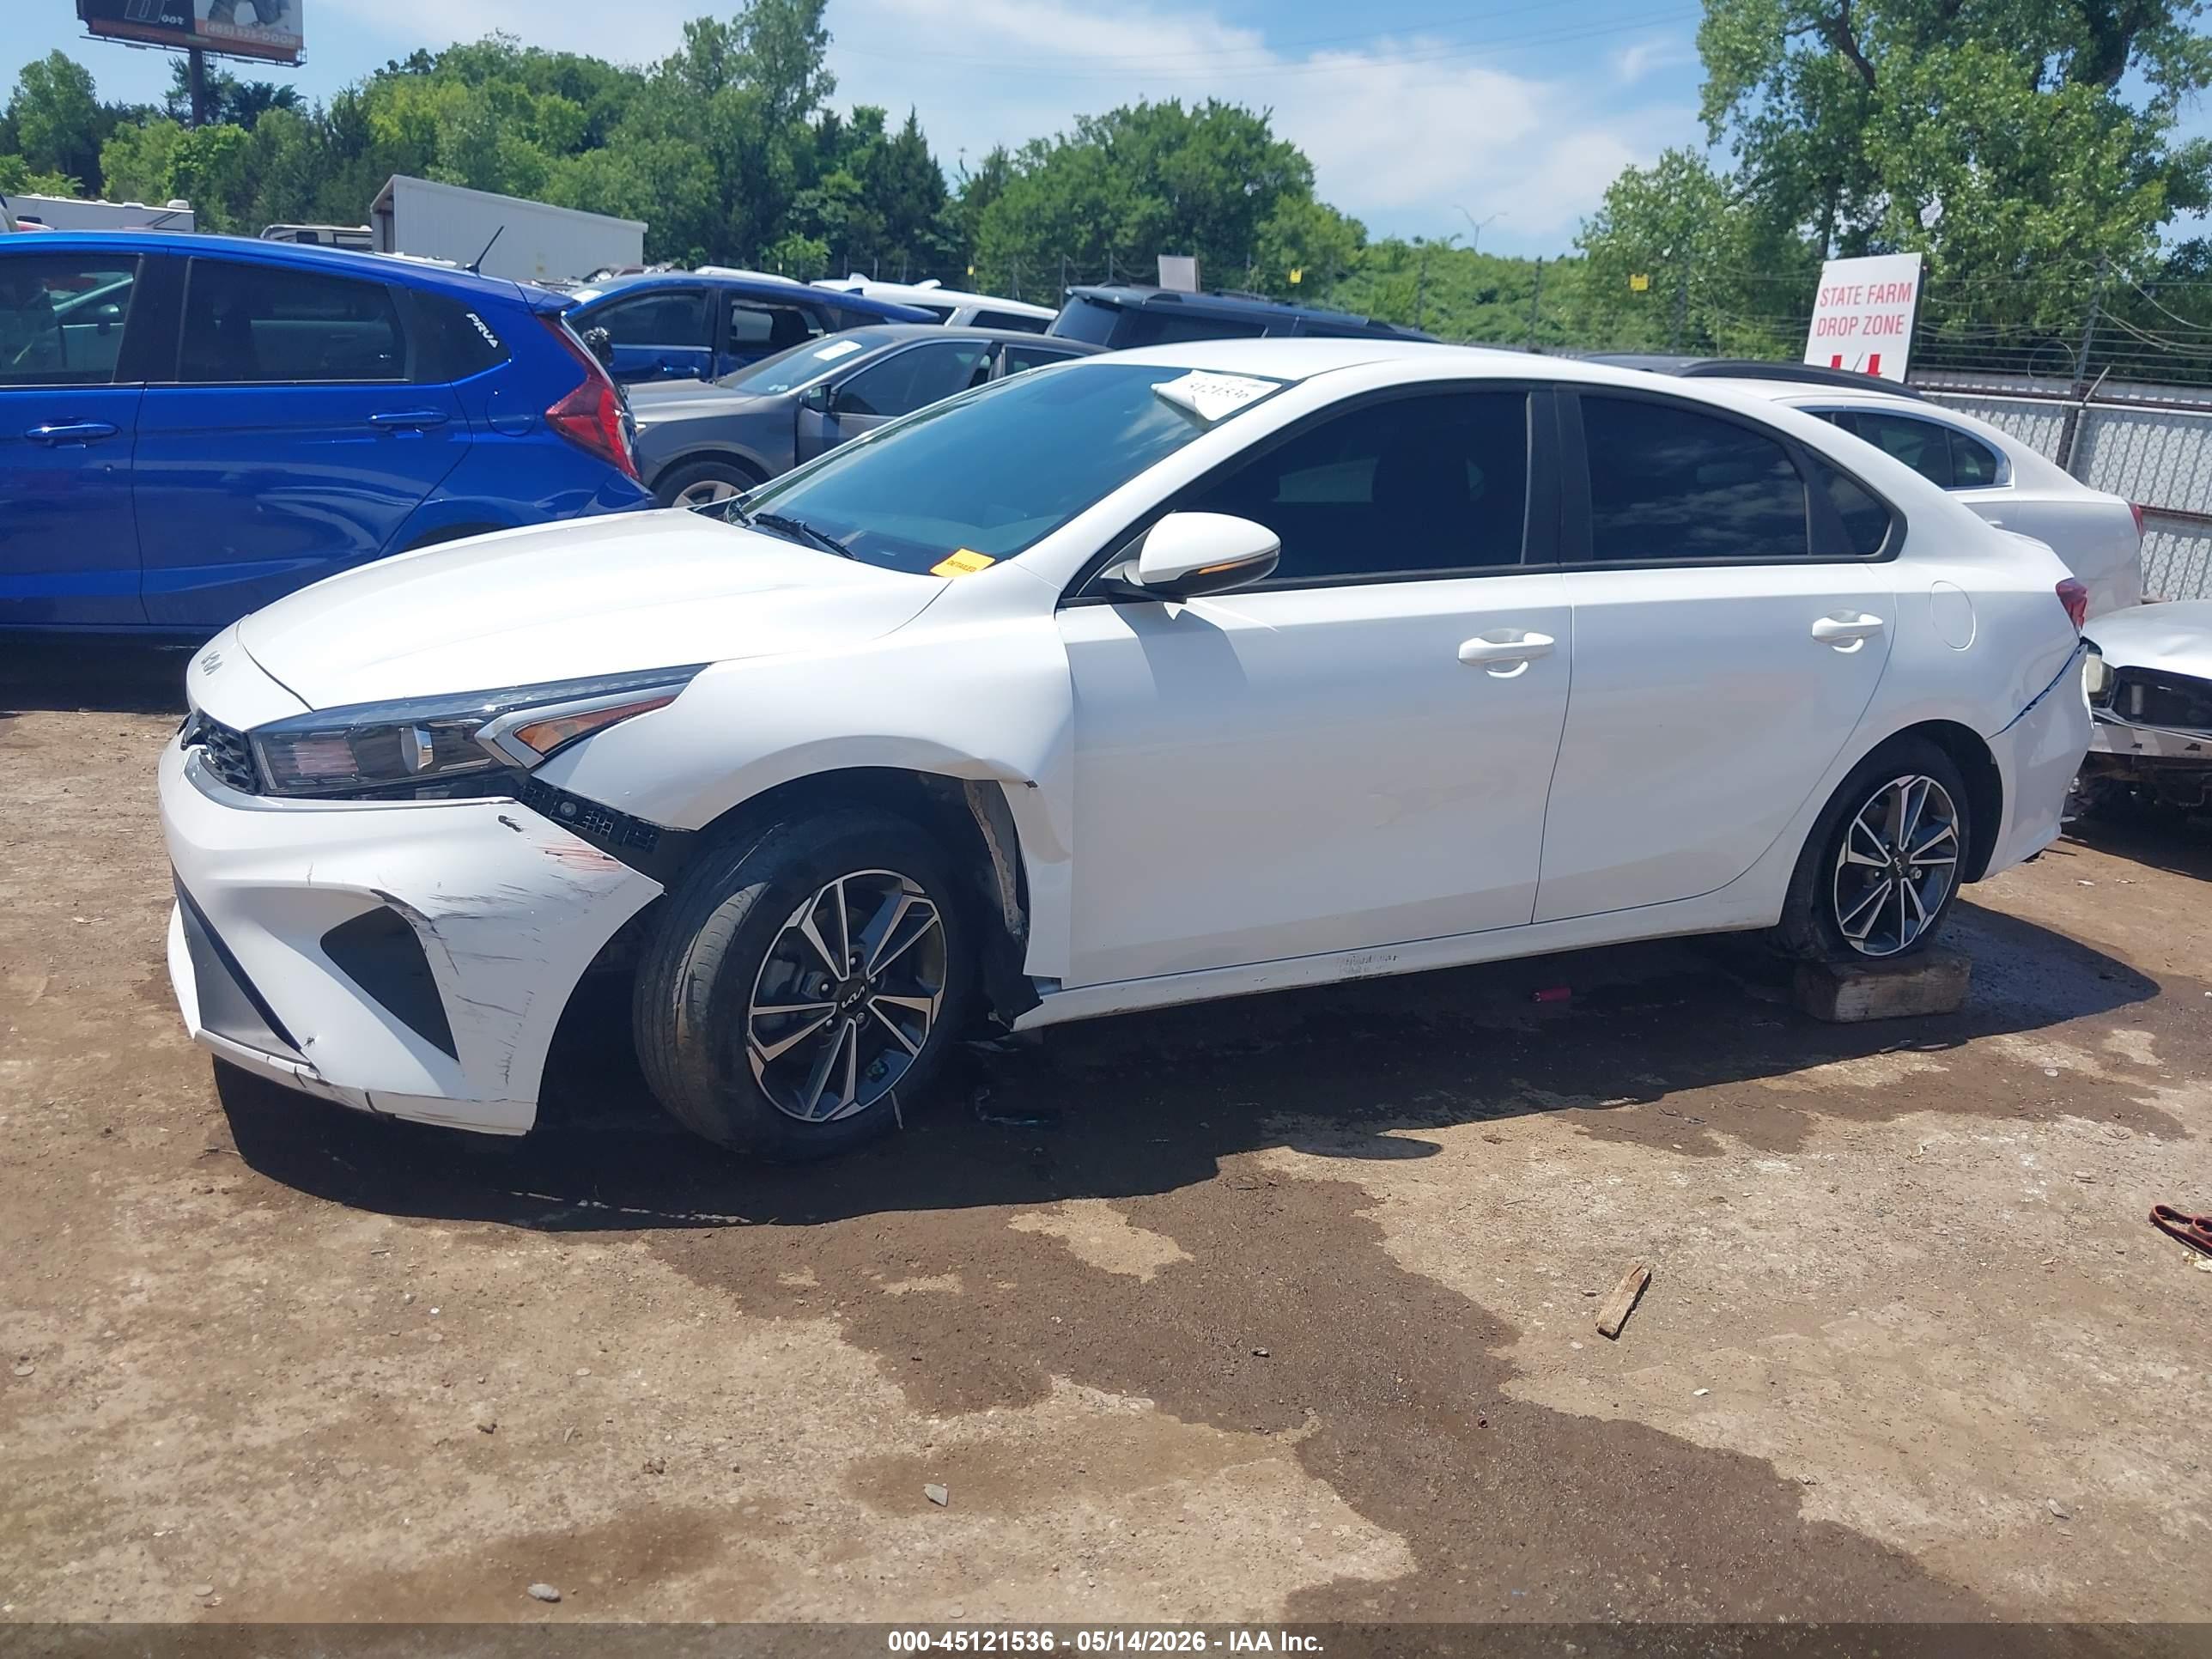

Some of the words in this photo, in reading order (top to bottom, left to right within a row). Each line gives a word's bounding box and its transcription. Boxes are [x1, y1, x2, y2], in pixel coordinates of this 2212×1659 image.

[1820, 285, 1863, 307] STATE
[1866, 282, 1912, 305] FARM
[1817, 315, 1858, 337] DROP
[1862, 313, 1905, 336] ZONE
